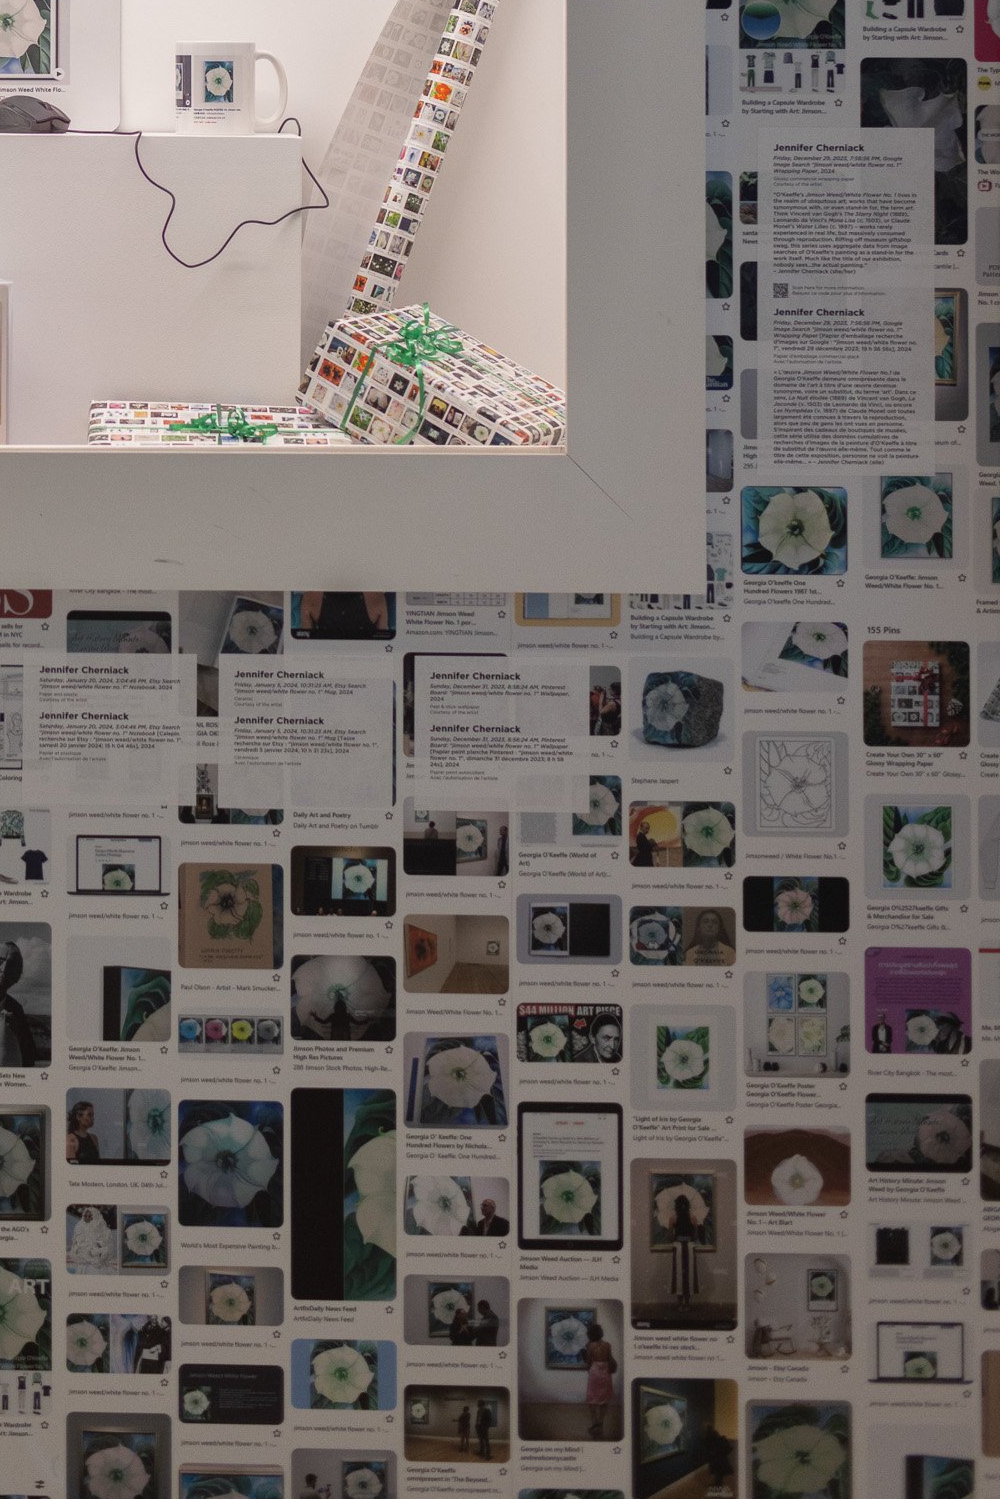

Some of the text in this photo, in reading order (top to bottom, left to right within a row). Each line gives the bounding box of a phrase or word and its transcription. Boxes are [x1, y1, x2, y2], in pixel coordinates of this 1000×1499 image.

[774, 308, 813, 316] Jennifer
[867, 626, 901, 634] 155 Pins
[81, 666, 129, 674] Cherniack
[277, 671, 324, 679] Cherniack
[472, 672, 520, 680] Cherniack
[81, 712, 129, 720] Cherniack
[234, 716, 273, 724] Jennifer
[472, 725, 520, 733] Cherniack
